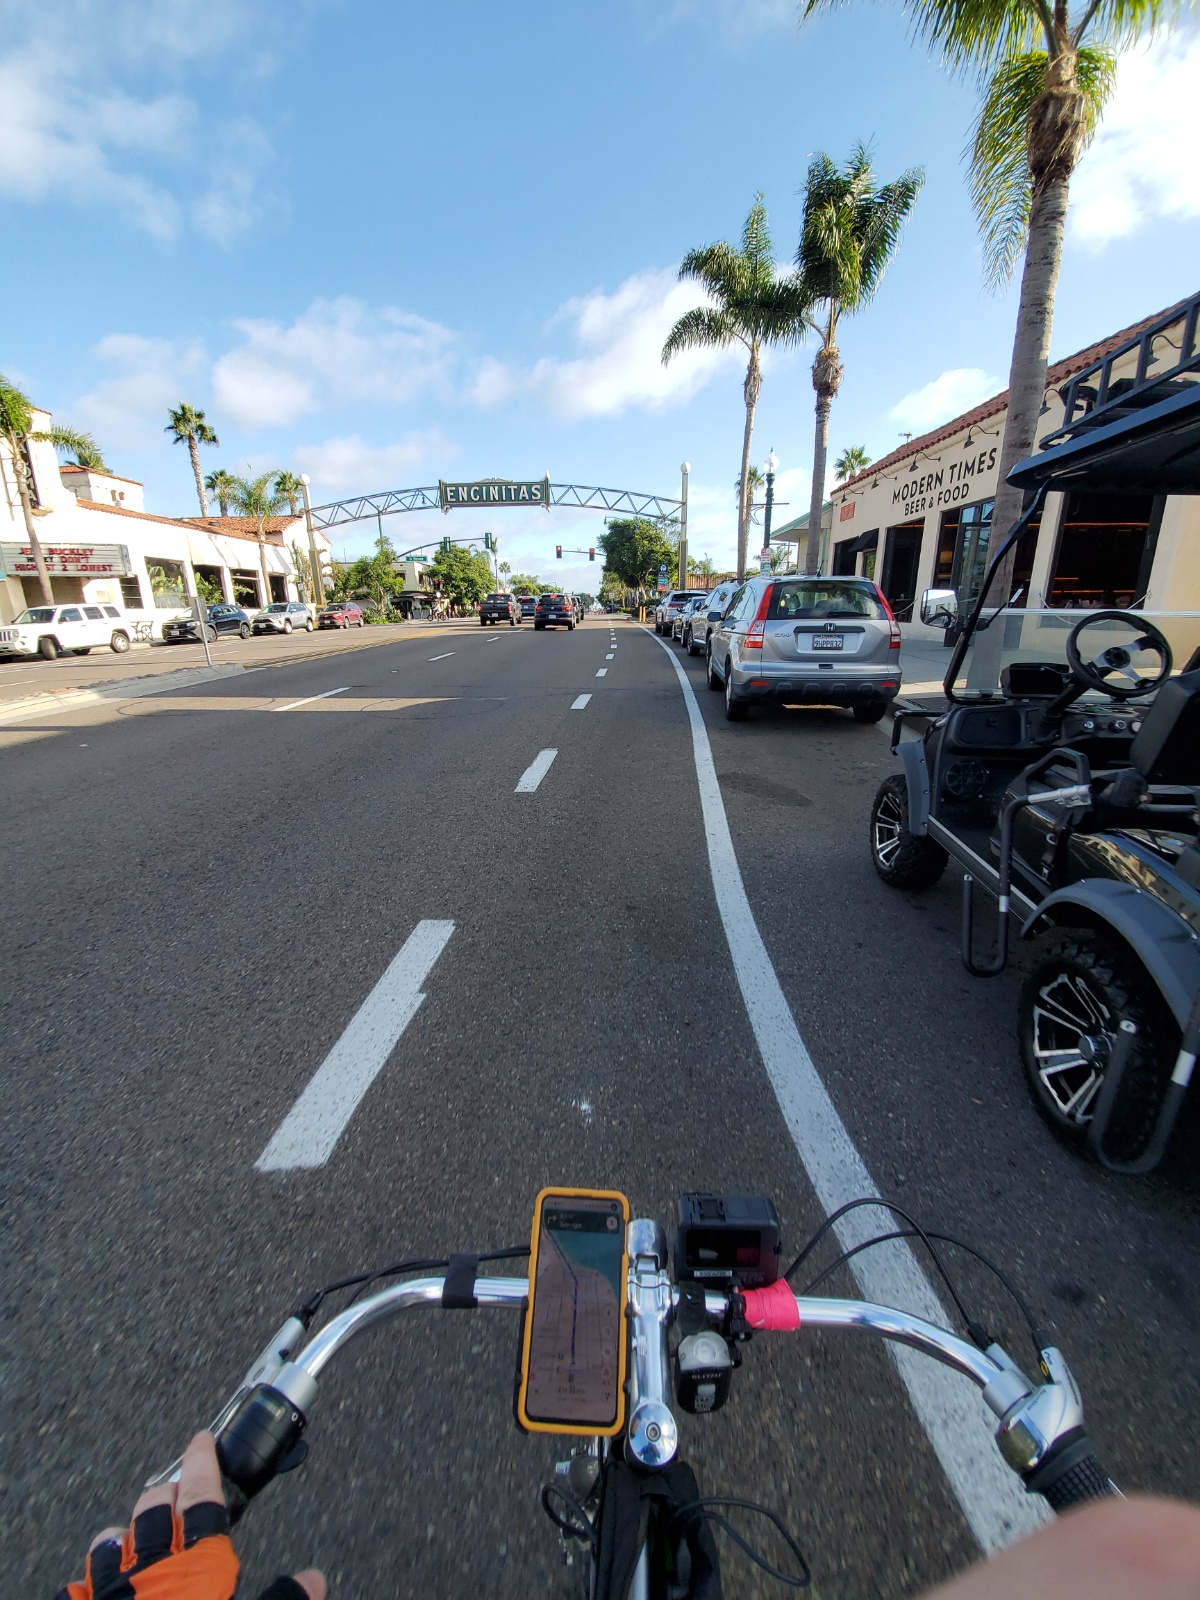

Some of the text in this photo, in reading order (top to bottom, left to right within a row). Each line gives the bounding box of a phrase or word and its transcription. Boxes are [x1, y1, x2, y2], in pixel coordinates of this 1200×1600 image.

[446, 485, 541, 501] ENCINITAS
[892, 447, 998, 505] MODERN TIMES
[904, 482, 970, 516] BEER & FOOD
